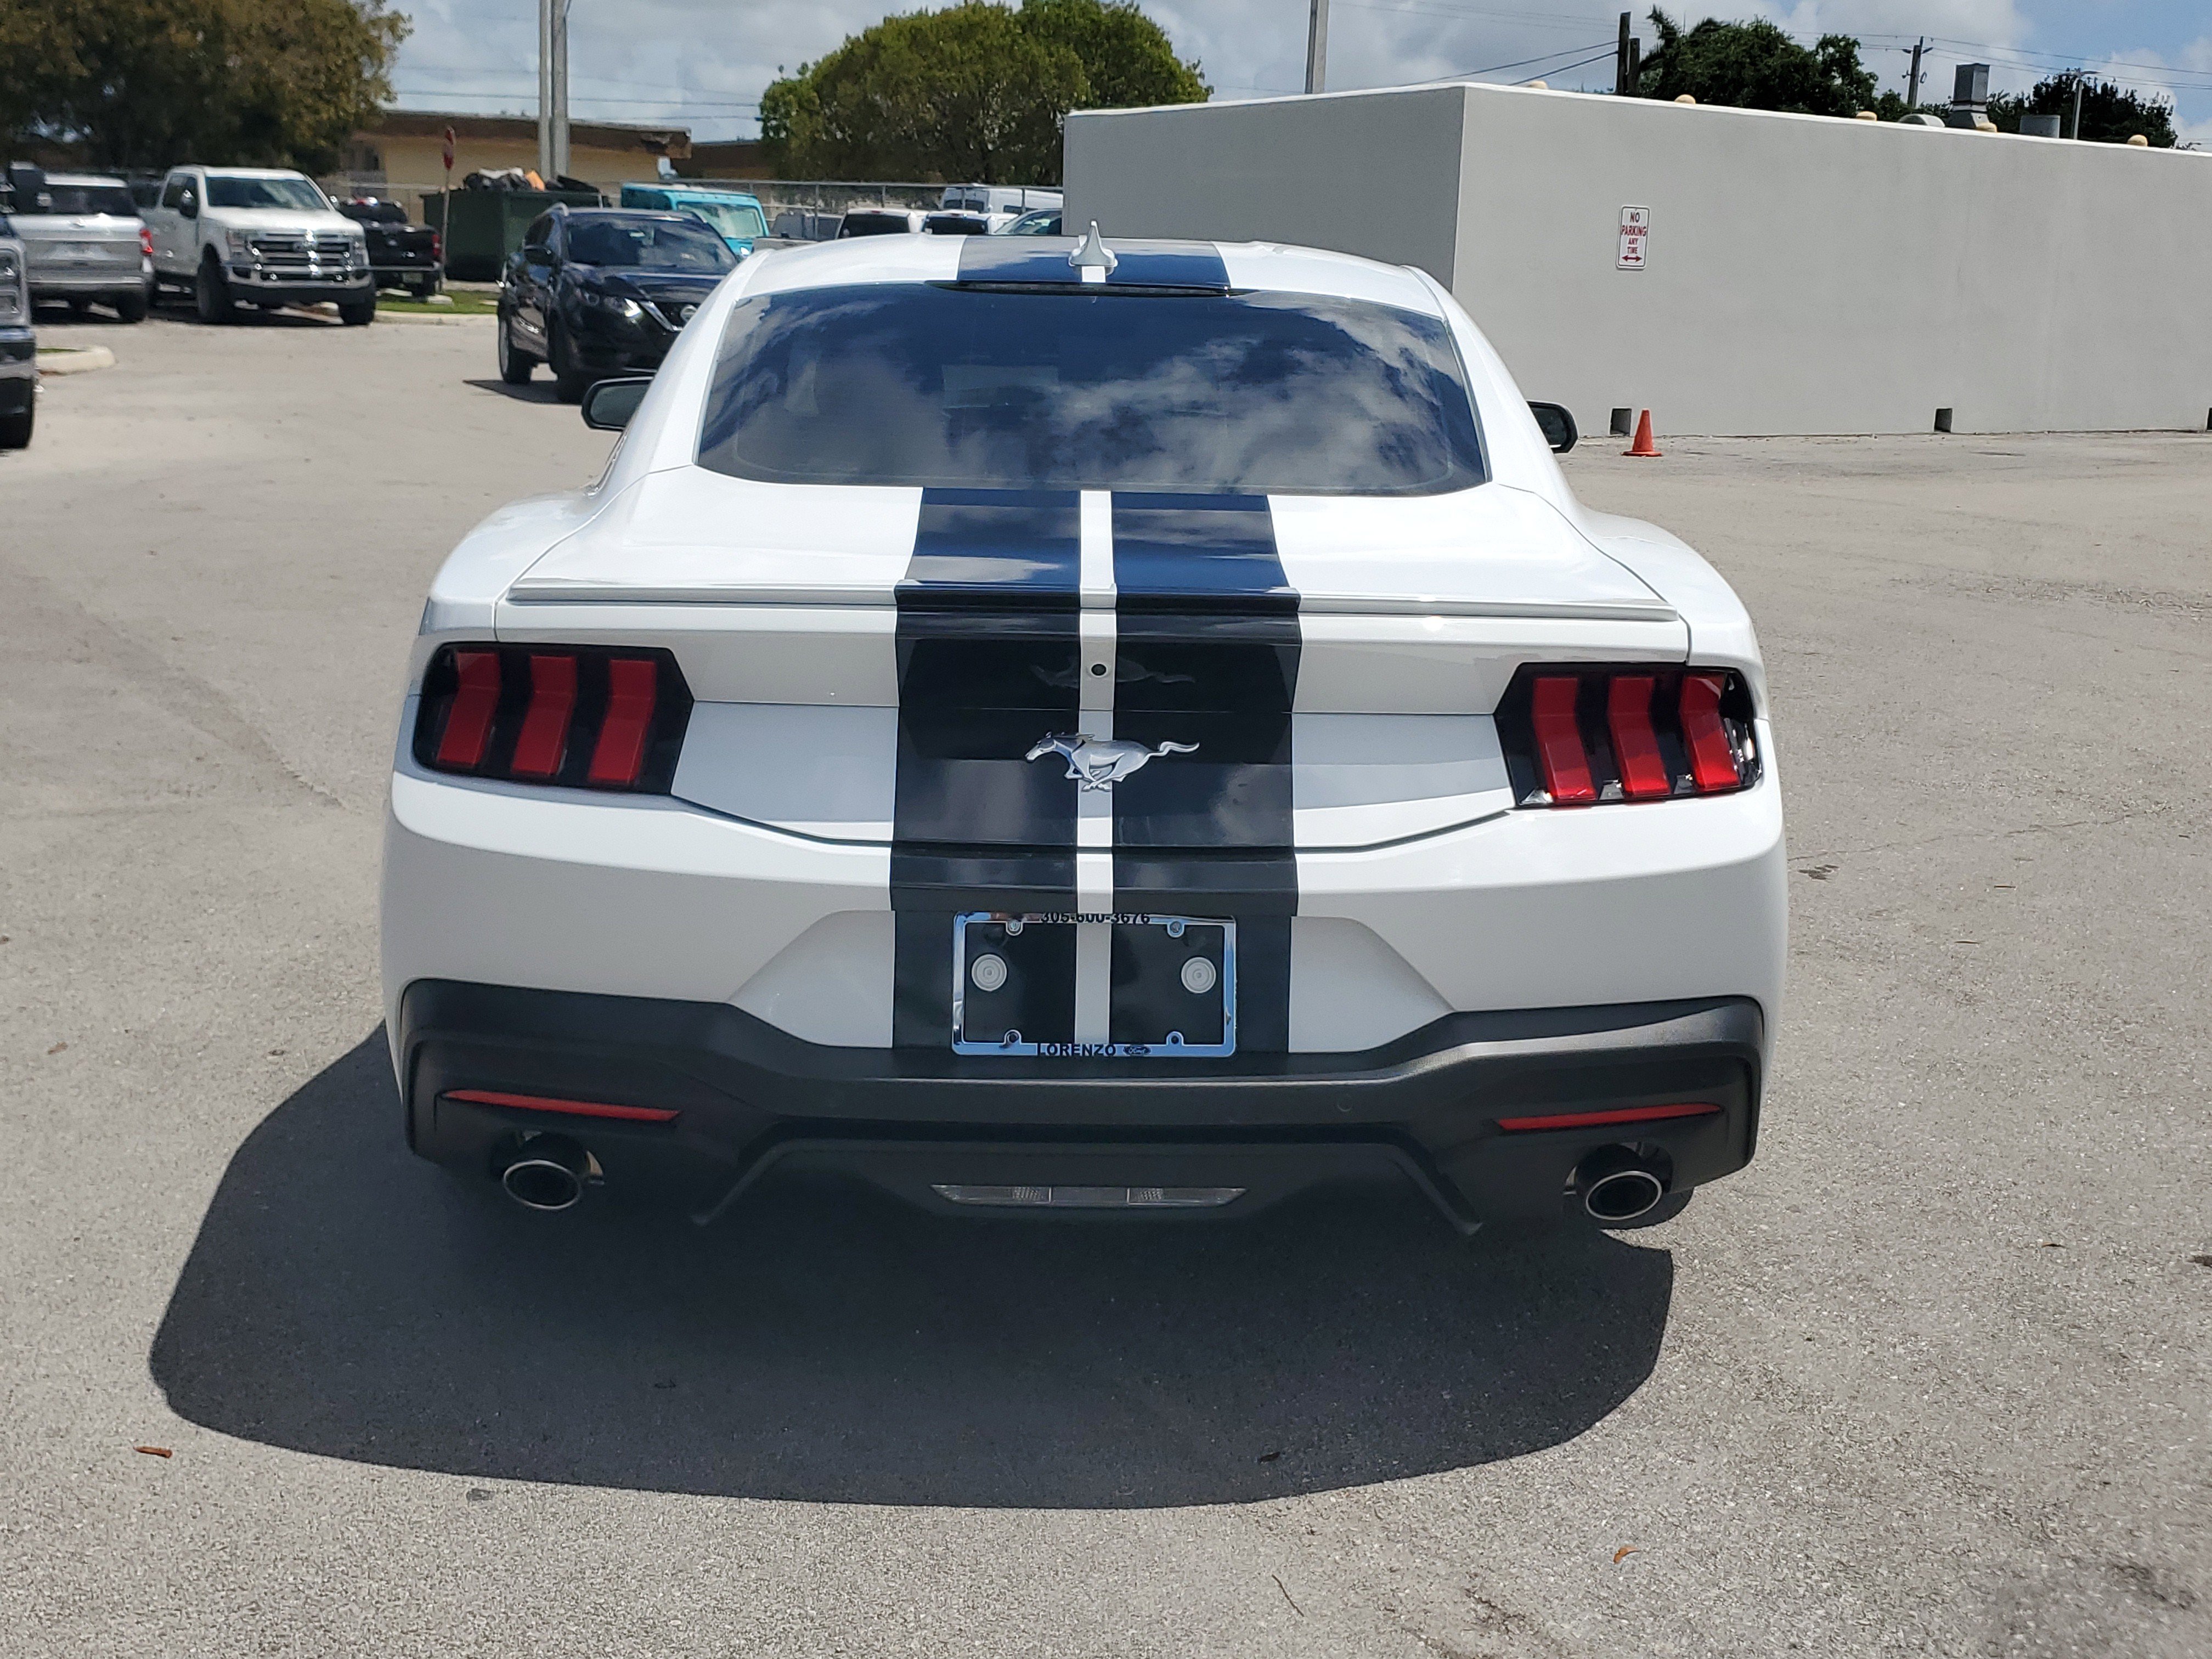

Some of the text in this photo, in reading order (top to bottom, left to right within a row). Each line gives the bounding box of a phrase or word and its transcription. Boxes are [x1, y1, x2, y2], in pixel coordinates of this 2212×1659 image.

[1630, 212, 1640, 223] NO
[1621, 224, 1647, 236] PARKING
[1042, 912, 1150, 925] 305-600-3676
[1037, 1043, 1116, 1057] LORENZO
